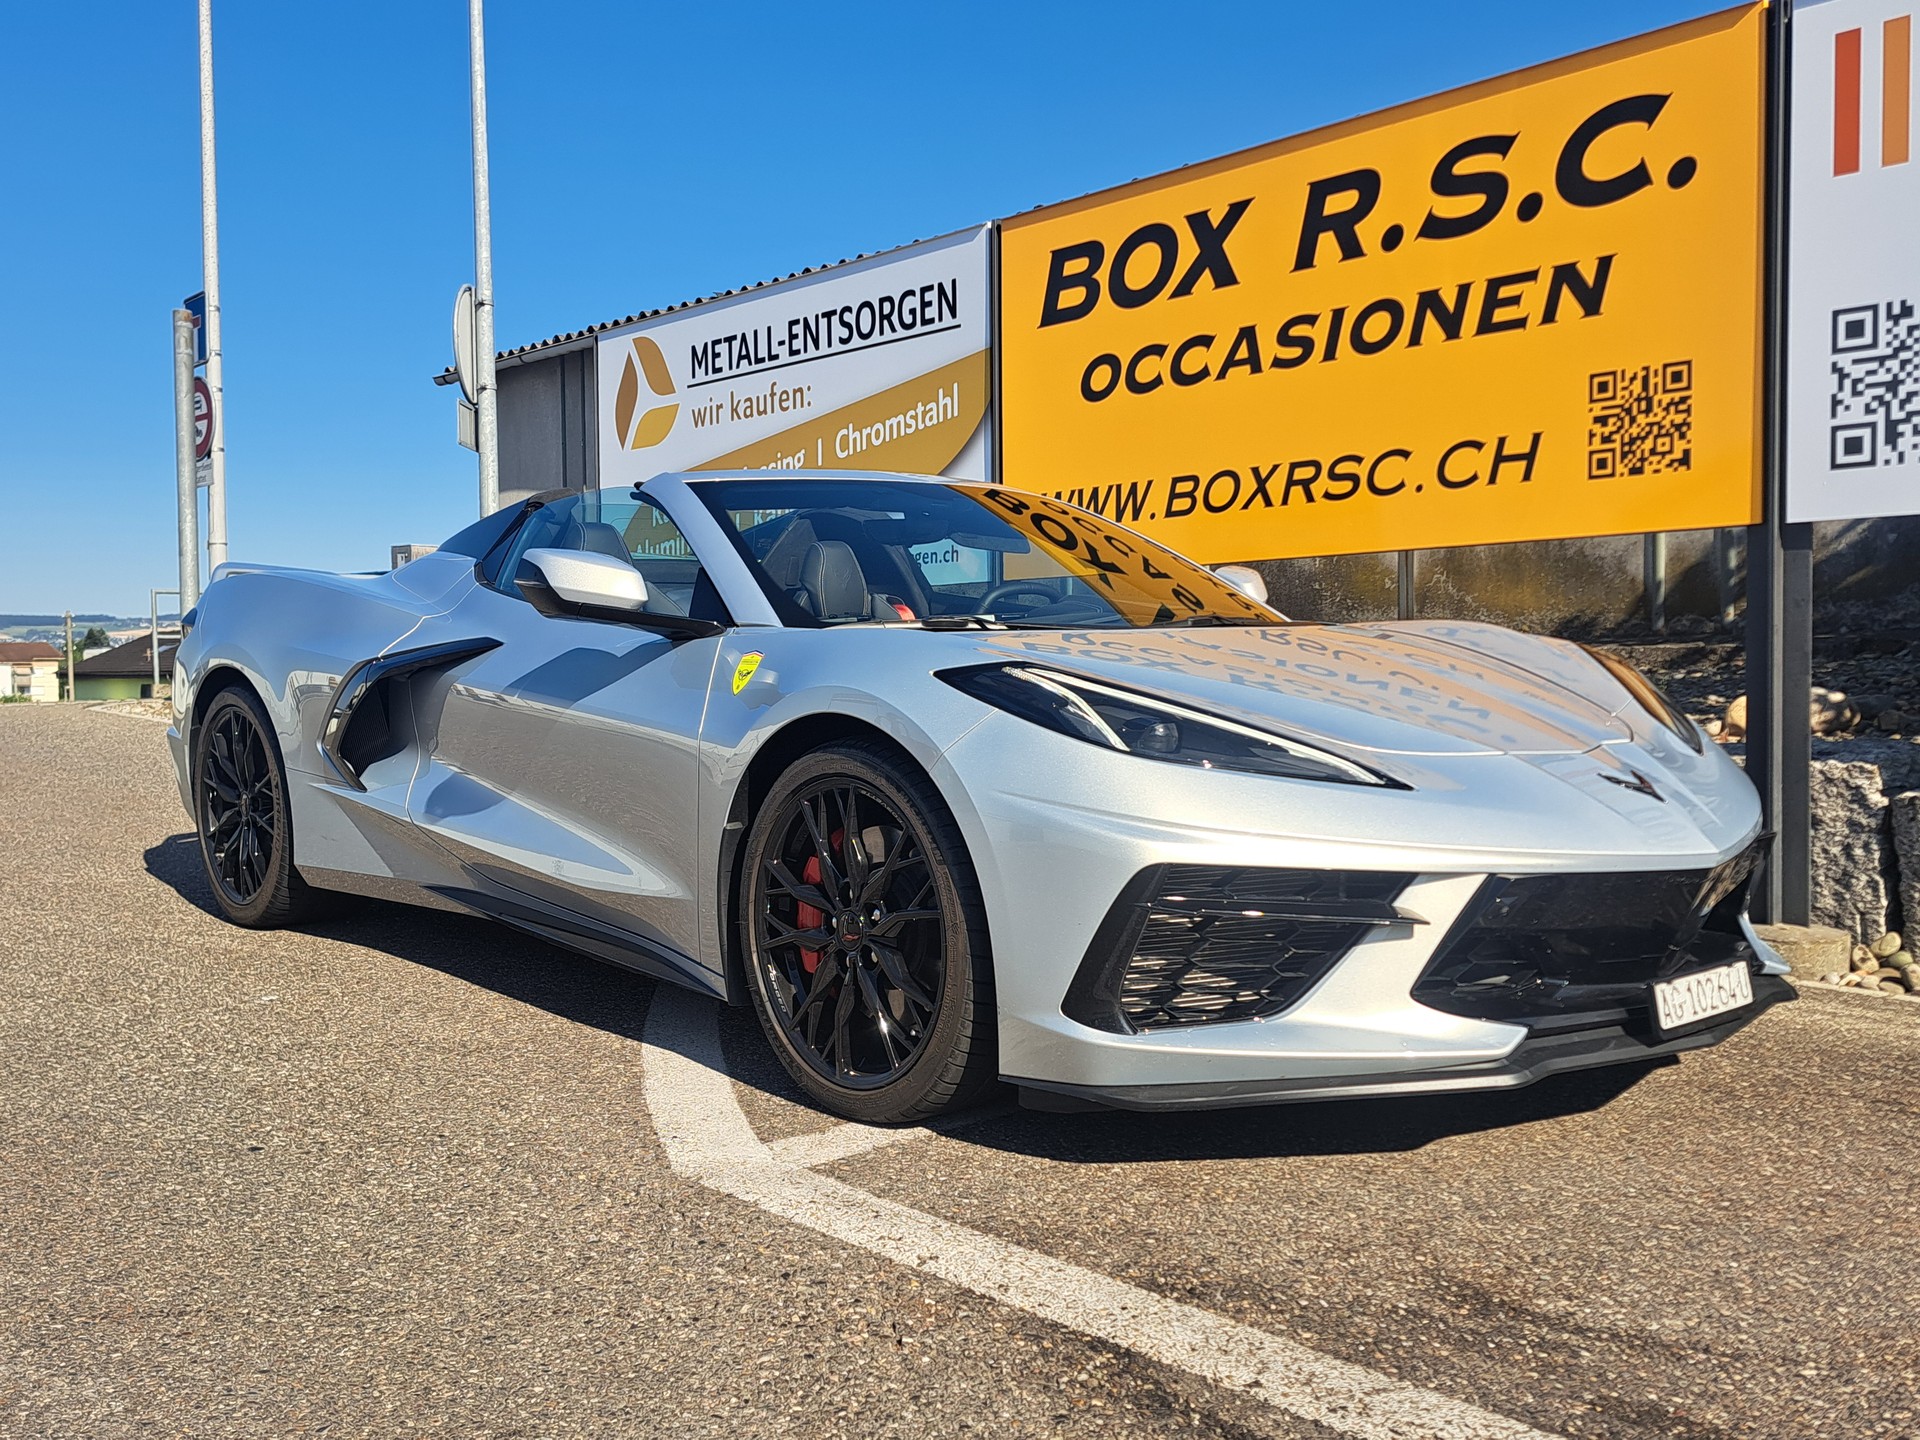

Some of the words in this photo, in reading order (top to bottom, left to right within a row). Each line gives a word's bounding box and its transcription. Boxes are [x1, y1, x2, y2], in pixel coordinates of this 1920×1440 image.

[1037, 197, 1256, 330] BOX
[1290, 92, 1698, 275] R.S.C.
[690, 278, 959, 380] METALL-ENTSORGEN
[1080, 253, 1617, 403] OCCASIONEN
[691, 396, 723, 429] wir
[730, 381, 813, 423] kaufen:
[835, 382, 960, 460] Chromstahl
